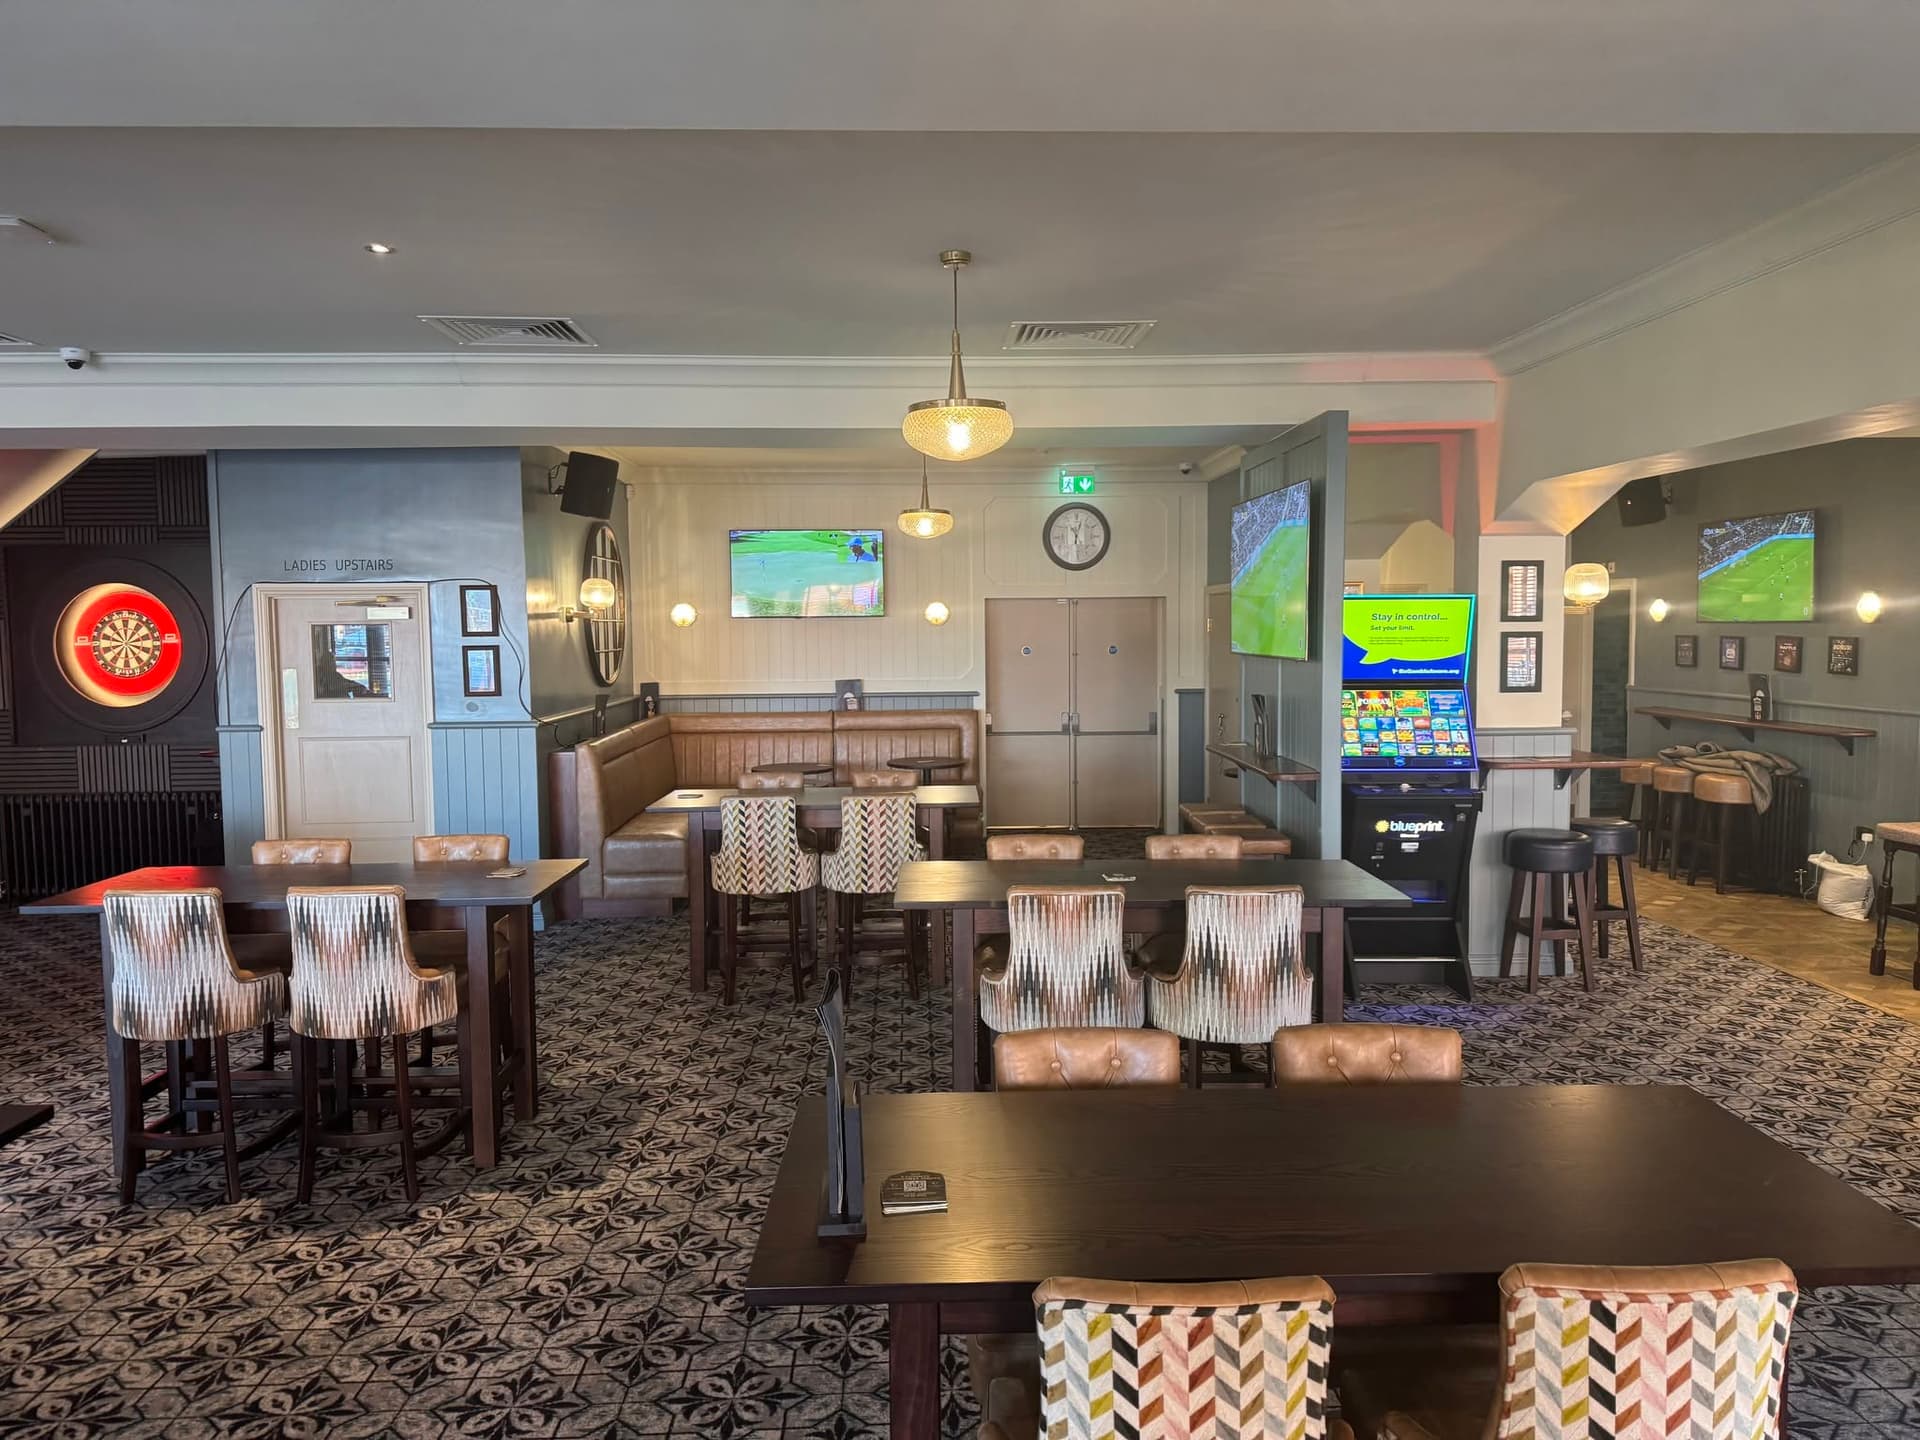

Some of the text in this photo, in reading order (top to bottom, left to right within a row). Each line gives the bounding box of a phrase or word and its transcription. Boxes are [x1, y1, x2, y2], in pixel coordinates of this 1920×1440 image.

[284, 559, 394, 571] LADIES UPSTAIRS
[1371, 612, 1392, 623] Stay
[1395, 612, 1404, 621] in
[1390, 820, 1445, 834] blueprint
